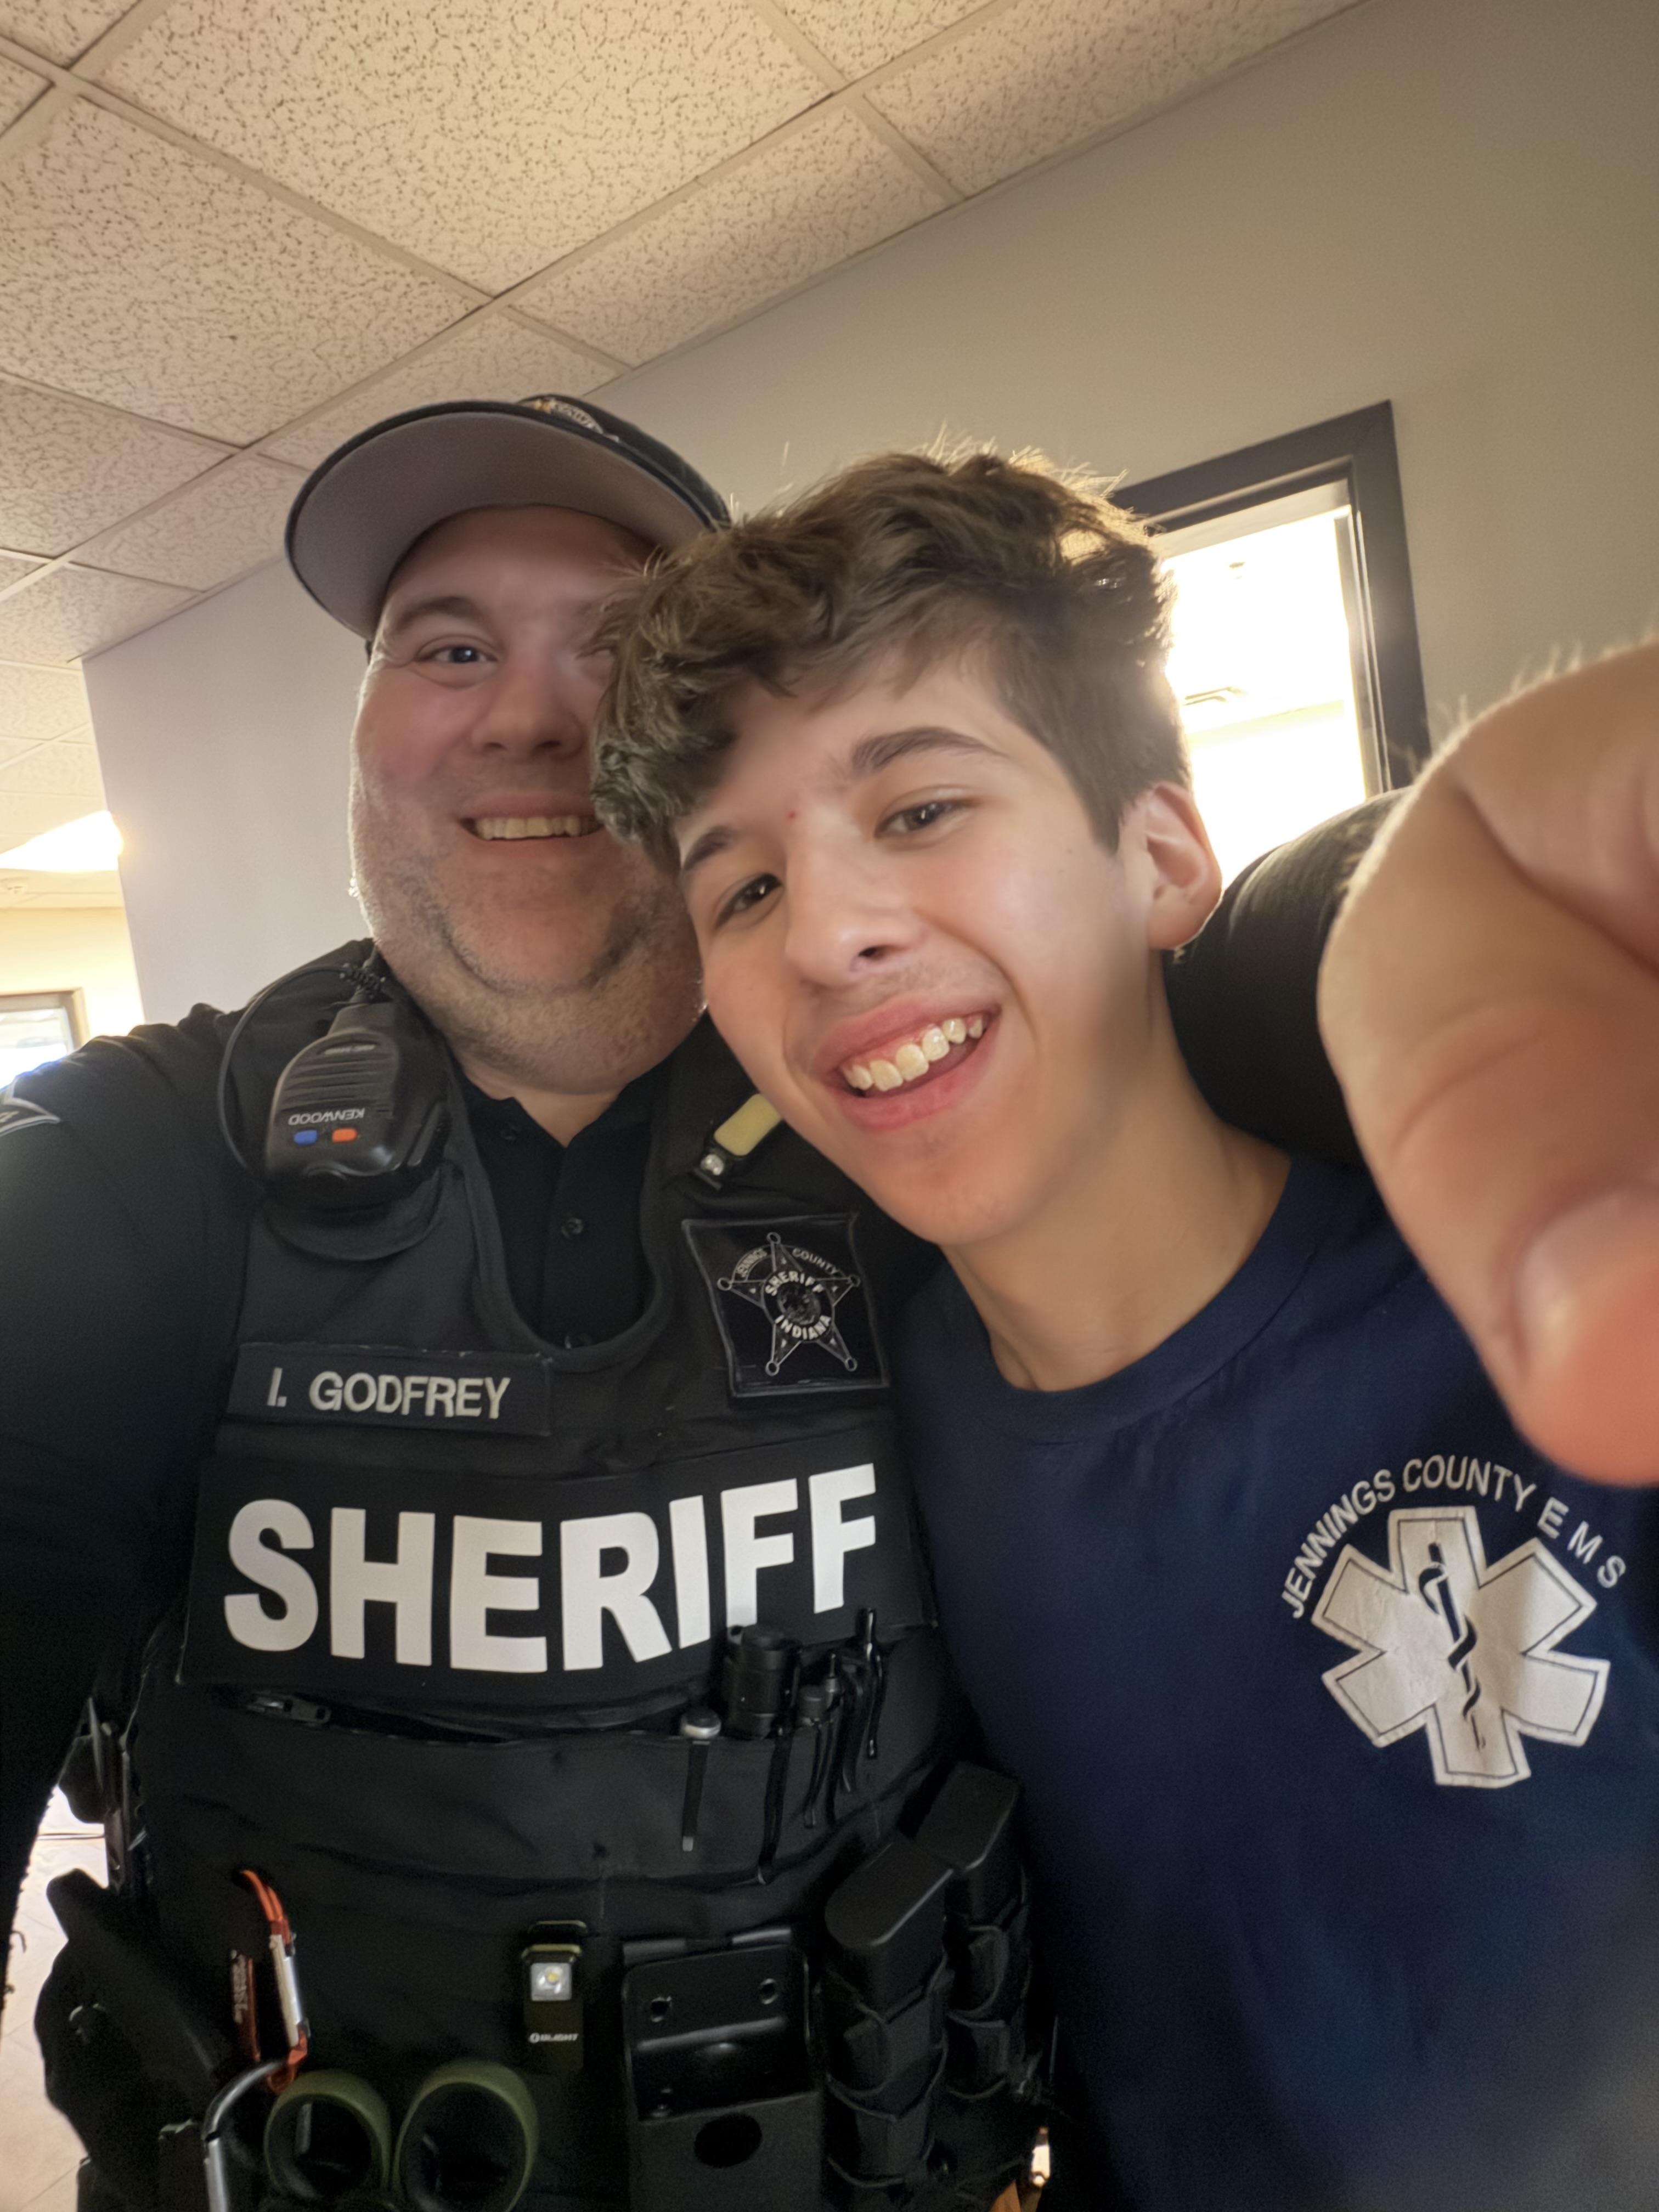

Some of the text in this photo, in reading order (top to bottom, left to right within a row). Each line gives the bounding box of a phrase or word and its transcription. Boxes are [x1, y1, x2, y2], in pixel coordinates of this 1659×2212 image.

[288, 1108, 365, 1125] KENWOOD
[792, 1247, 840, 1275] COUNTY
[765, 1271, 823, 1296] SHERIFF
[774, 1314, 831, 1340] INDIANA
[309, 1371, 511, 1419] GODFREY
[1281, 1469, 1396, 1618] JENNINGS
[1402, 1454, 1537, 1512] COUNTY
[224, 1463, 877, 1673] SHERIFF
